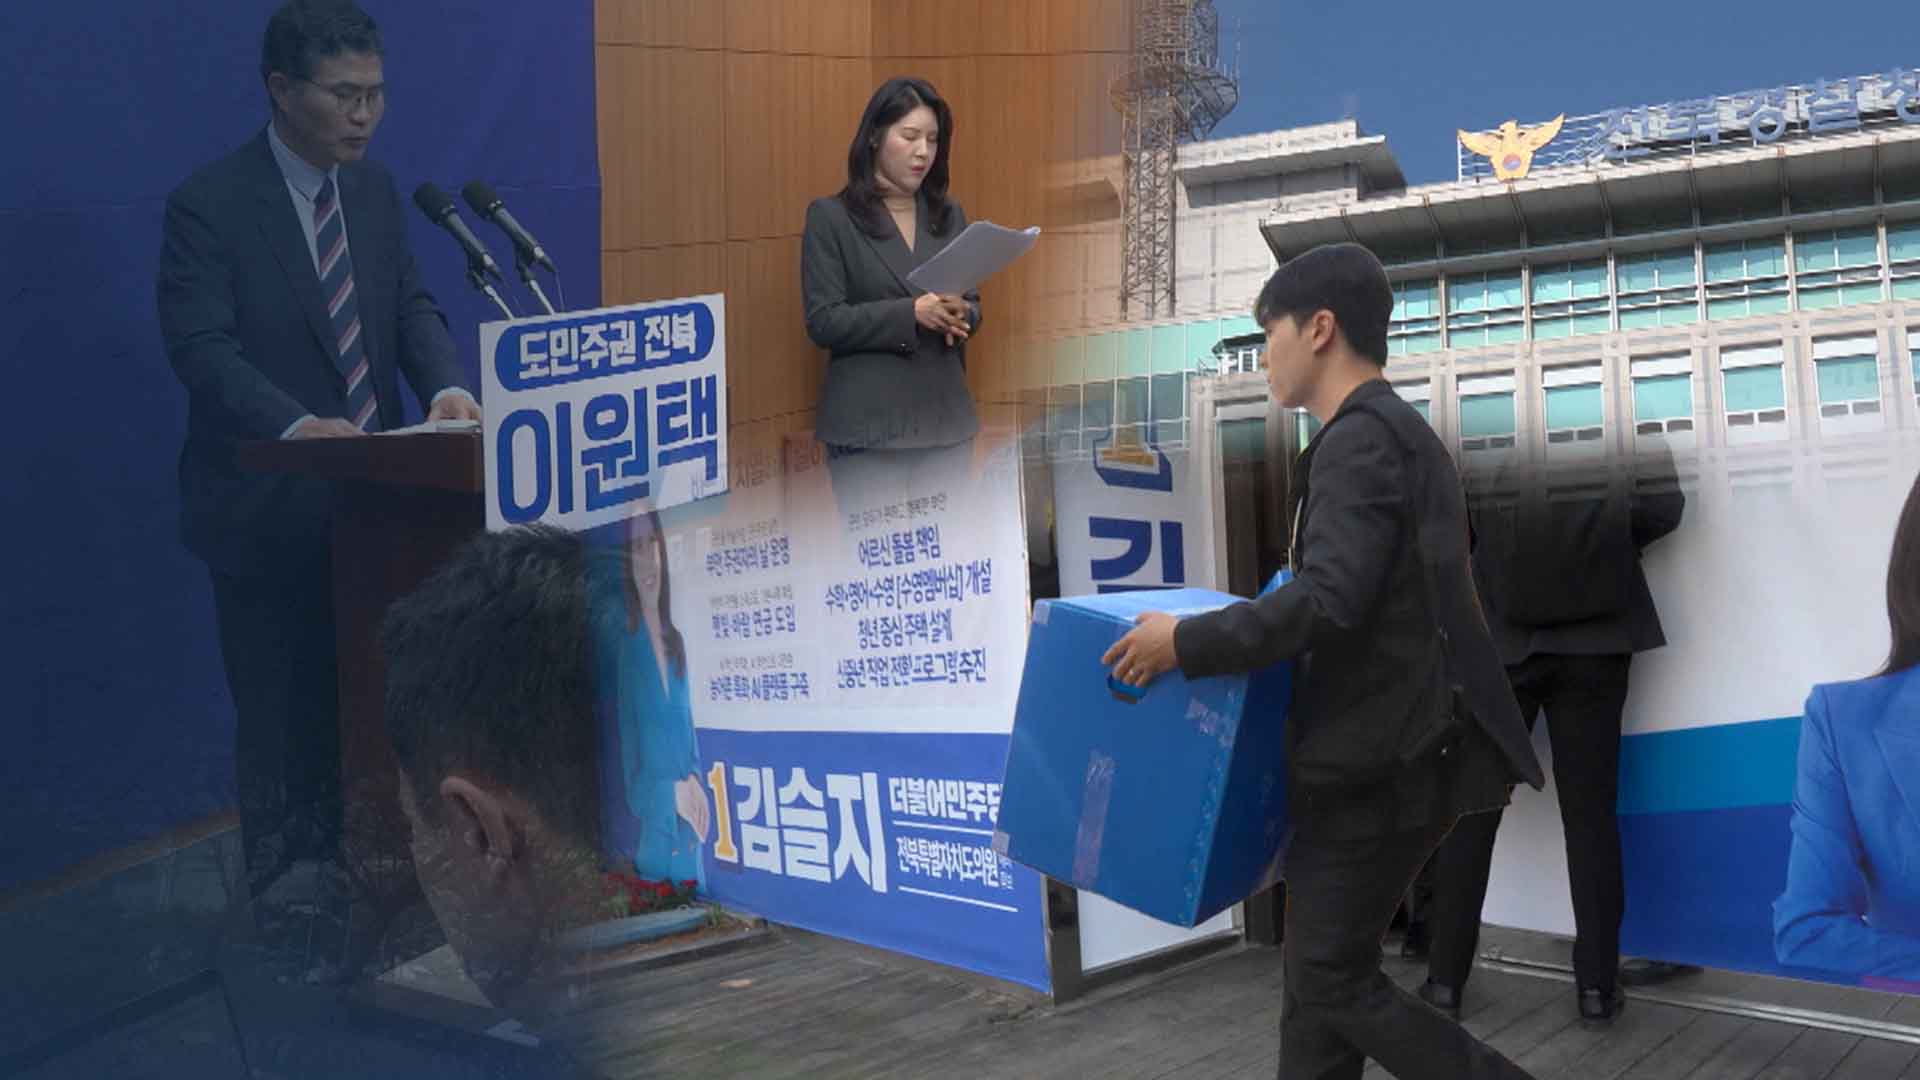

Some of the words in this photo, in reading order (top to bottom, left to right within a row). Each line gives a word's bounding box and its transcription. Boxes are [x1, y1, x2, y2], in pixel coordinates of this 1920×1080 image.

[519, 320, 636, 380] 도민주권
[644, 311, 697, 361] 전북
[496, 374, 718, 525] 이원택
[858, 536, 891, 569] 어르신
[892, 530, 915, 566] 돌봄
[916, 523, 942, 559] 책임
[965, 558, 992, 597] 개설
[775, 603, 796, 633] 도입
[858, 618, 880, 649] 청년
[904, 610, 928, 646] 주택
[929, 607, 953, 643] 설계
[912, 649, 958, 684] 프로그램
[958, 647, 987, 682] 추진
[706, 761, 738, 864] 1
[733, 765, 888, 893] 김슬지
[896, 836, 1000, 889] 전북특별자치도의원
